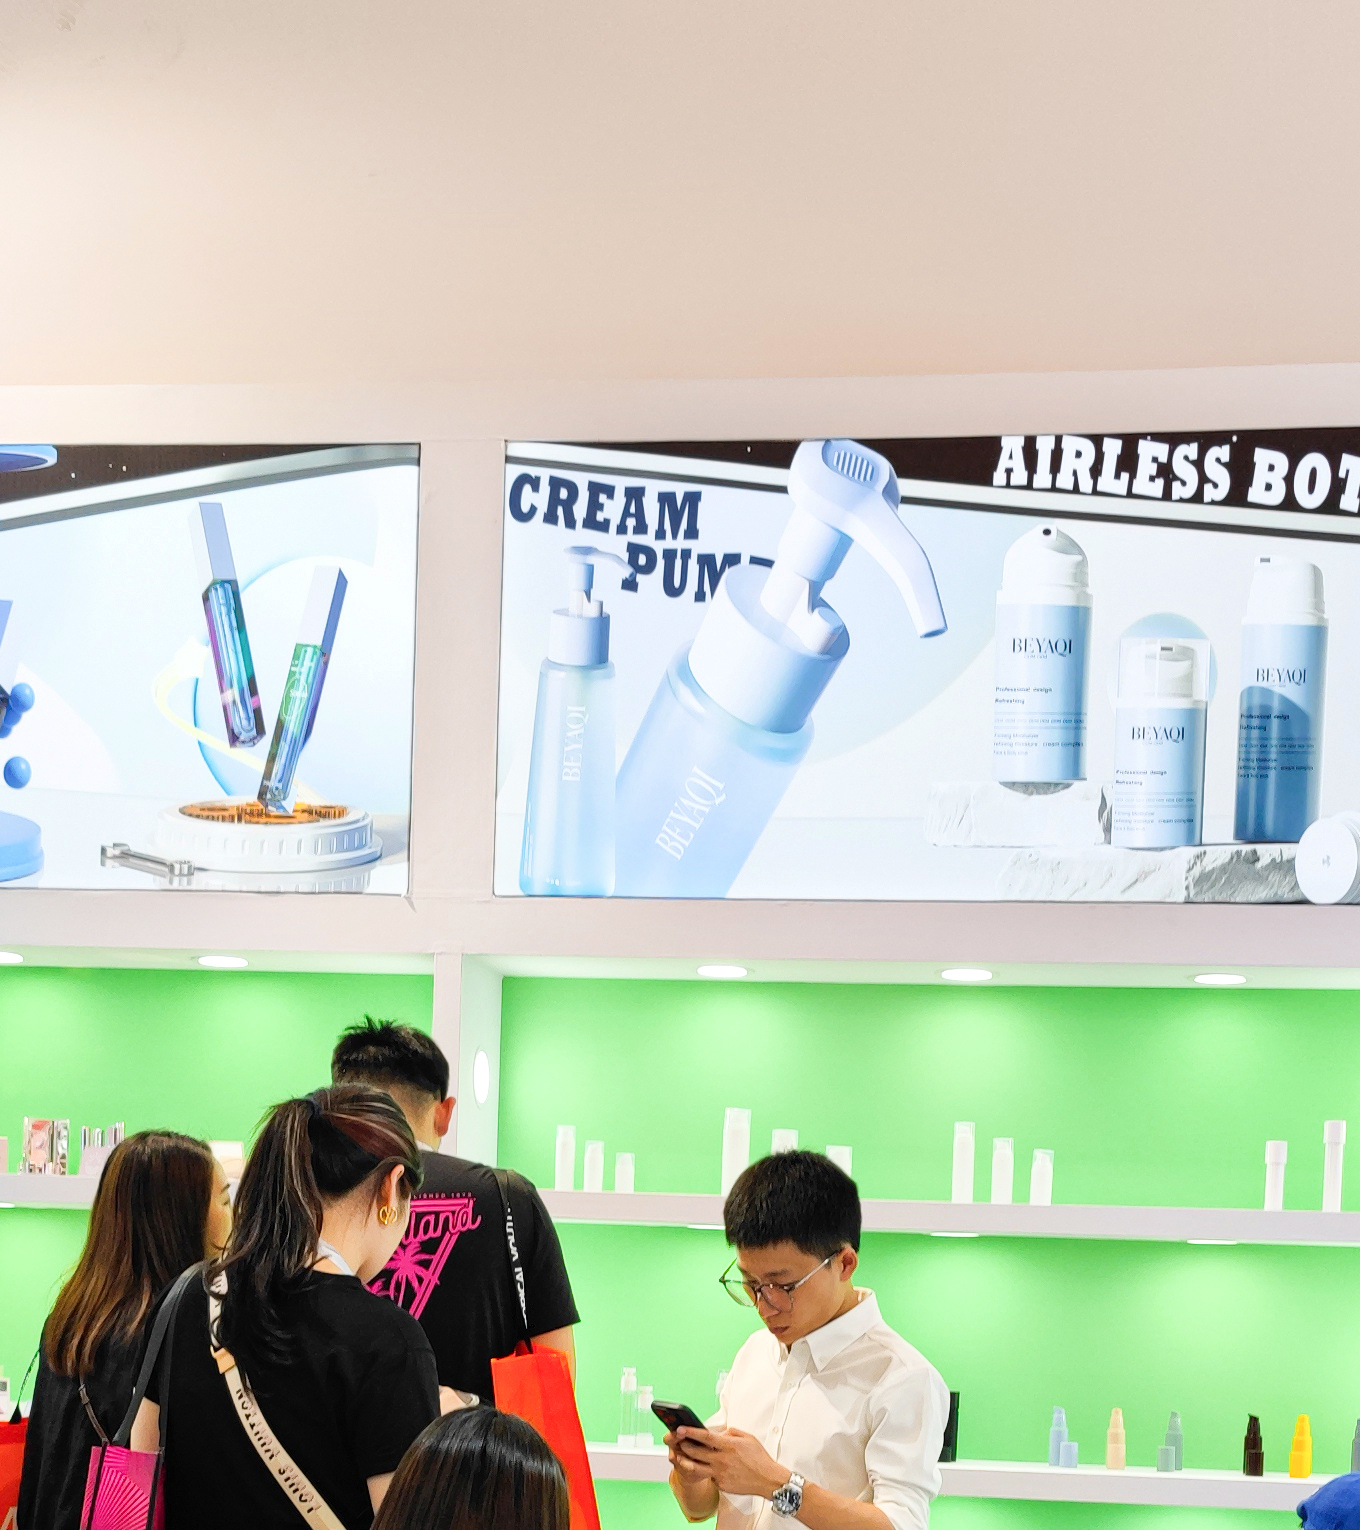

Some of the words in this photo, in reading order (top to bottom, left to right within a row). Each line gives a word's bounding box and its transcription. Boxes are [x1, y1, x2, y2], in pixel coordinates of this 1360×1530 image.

[992, 433, 1232, 504] AIRLESS
[508, 472, 702, 541] CREAM
[620, 541, 778, 604] PUM
[1012, 636, 1073, 659] BEYAQI
[560, 704, 590, 783] BEYAQI
[654, 764, 728, 861] BEYAQI
